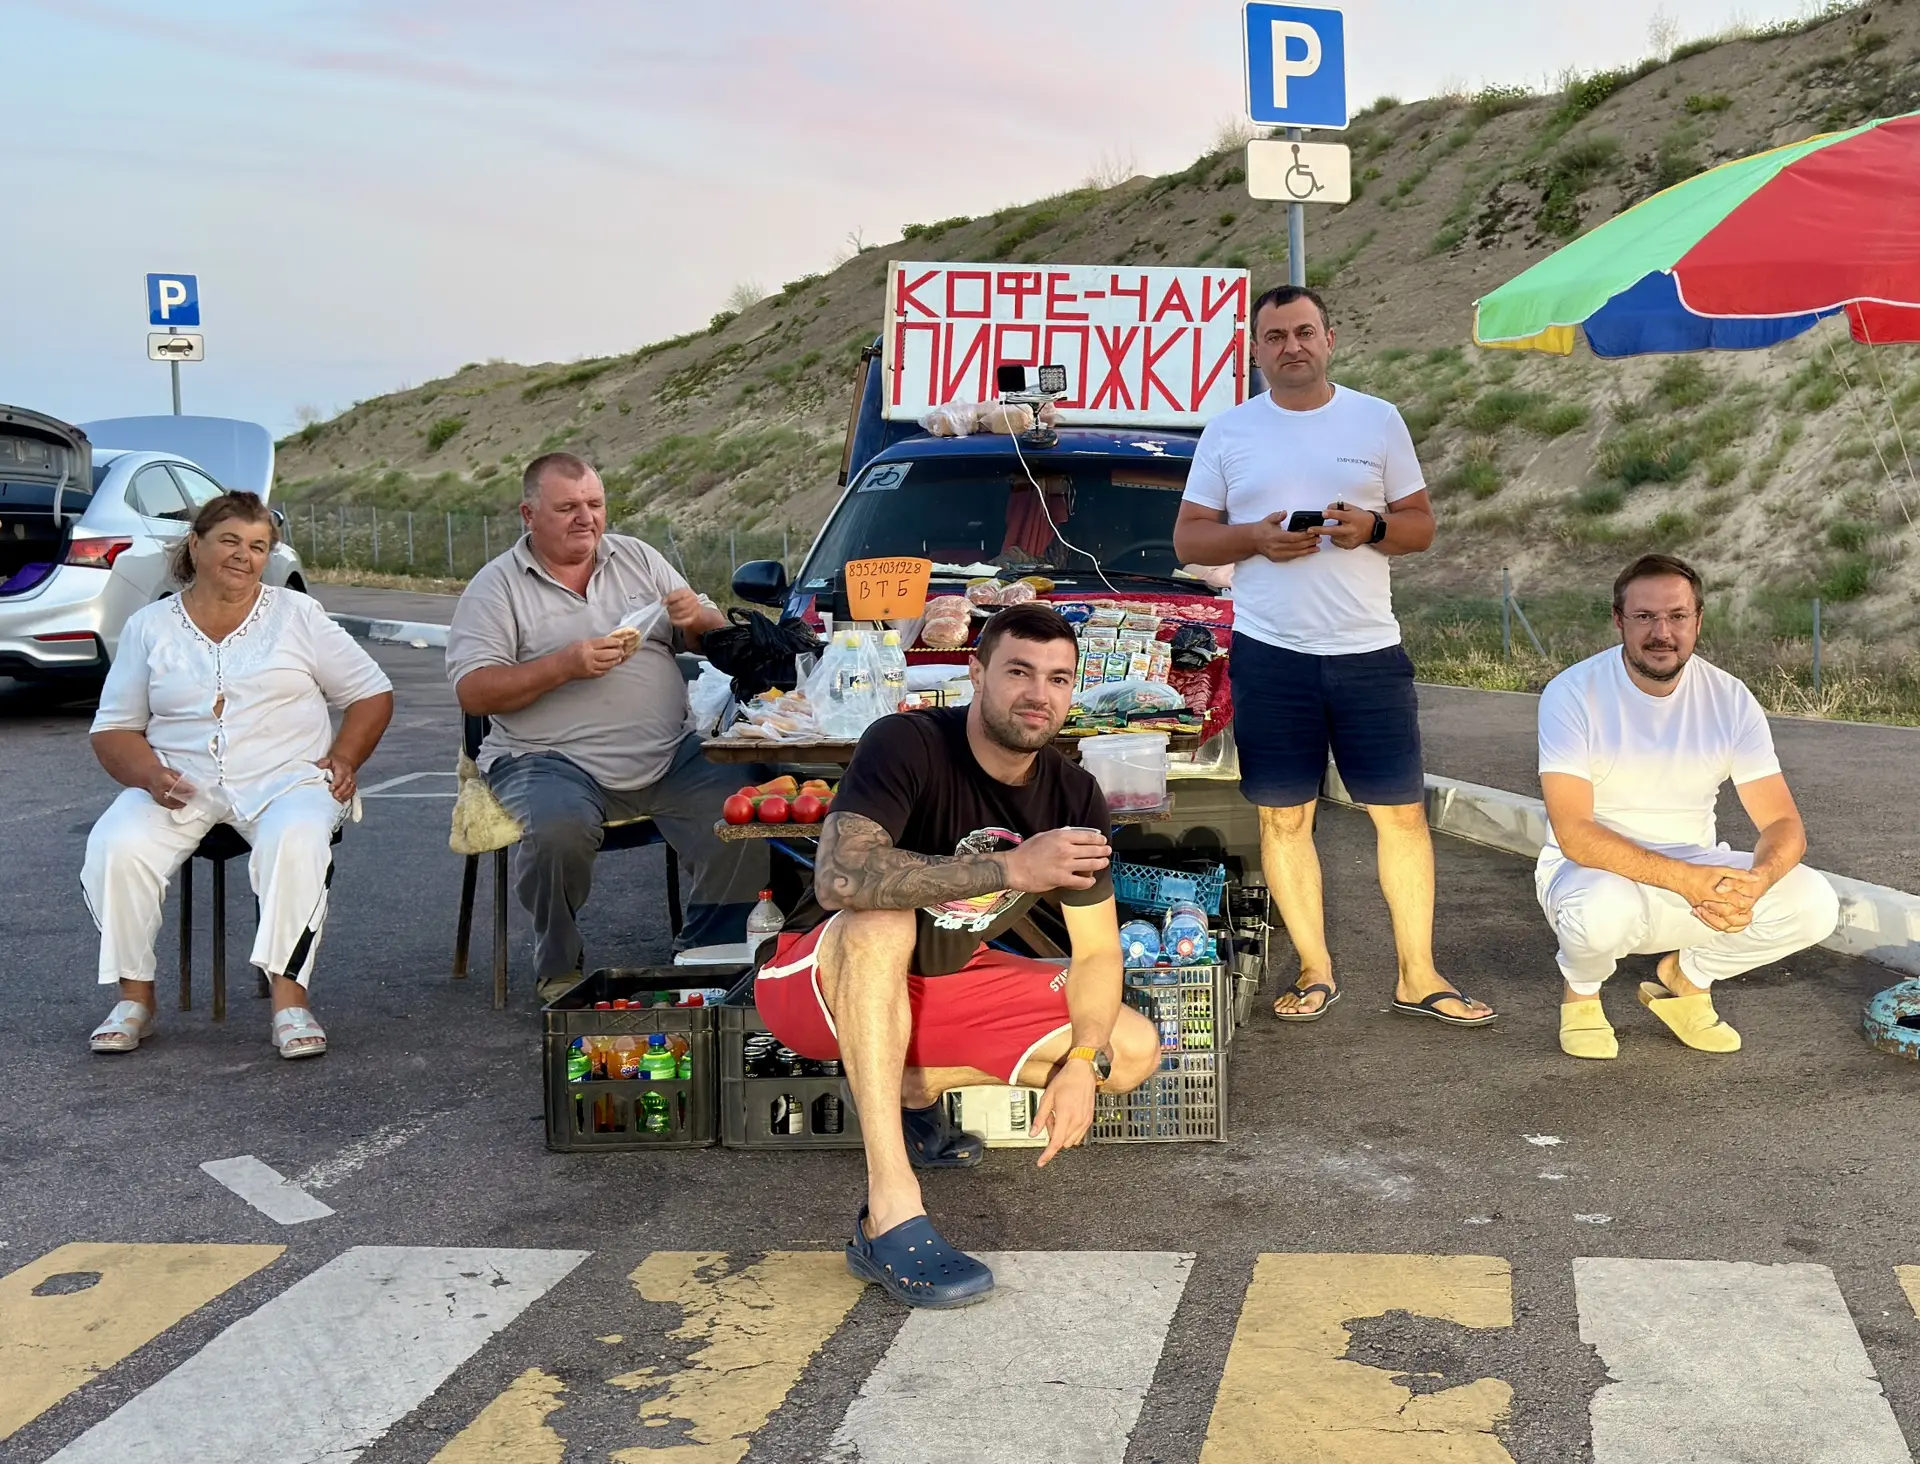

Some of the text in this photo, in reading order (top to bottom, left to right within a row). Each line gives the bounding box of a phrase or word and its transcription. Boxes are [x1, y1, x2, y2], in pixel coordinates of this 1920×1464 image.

[1271, 20, 1322, 109] P
[158, 279, 187, 320] P
[897, 269, 1247, 323] КОФЕ-ЧАЙ
[892, 321, 1246, 412] ПИРОЖКИ
[849, 561, 922, 577] 89521031928
